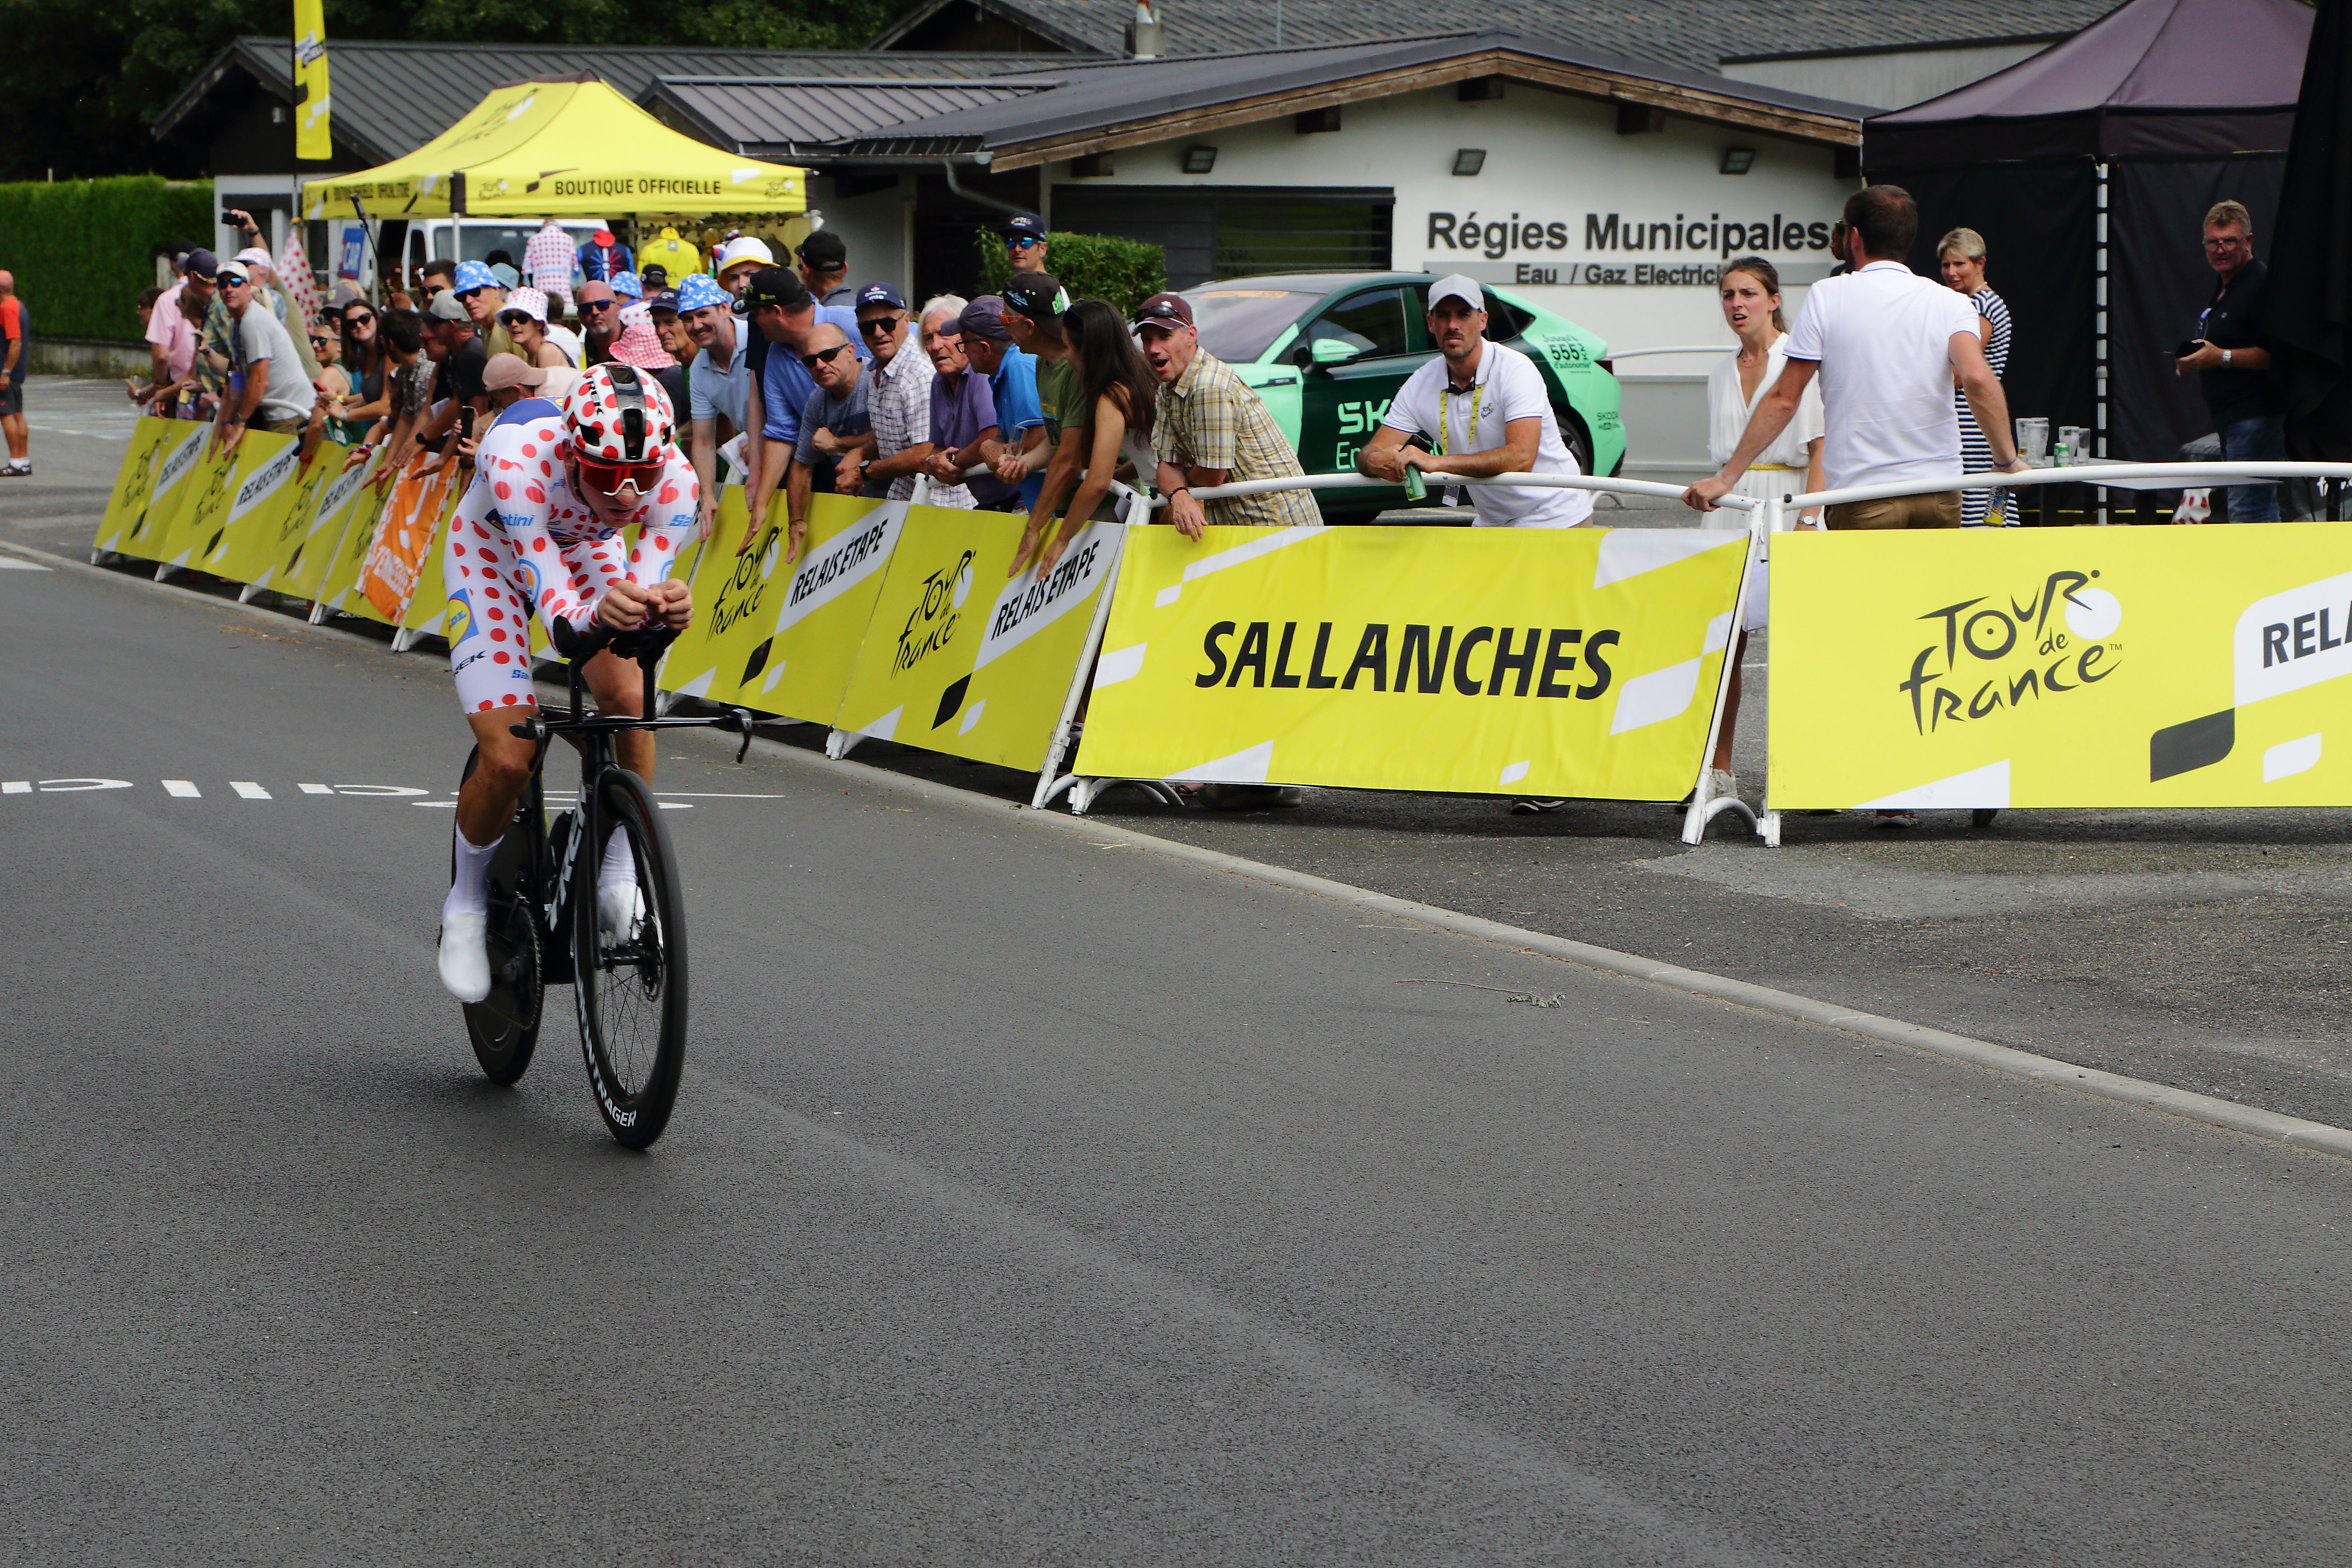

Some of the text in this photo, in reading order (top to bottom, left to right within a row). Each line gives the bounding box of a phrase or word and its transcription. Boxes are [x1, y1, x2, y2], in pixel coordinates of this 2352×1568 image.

[555, 179, 721, 195] BOUTIQUE OFFICIELLE
[1428, 212, 1830, 259] Régies Municipales
[1516, 264, 1557, 284] Eau
[1585, 264, 1627, 285] Gaz
[1549, 343, 1580, 360] 555
[1337, 399, 1391, 434] SK
[790, 518, 889, 607] RELAIS ÉTAPE
[990, 539, 1101, 641] RELAIS ÉTAPE
[2038, 626, 2069, 656] de
[1194, 621, 1621, 701] SALLANCHES
